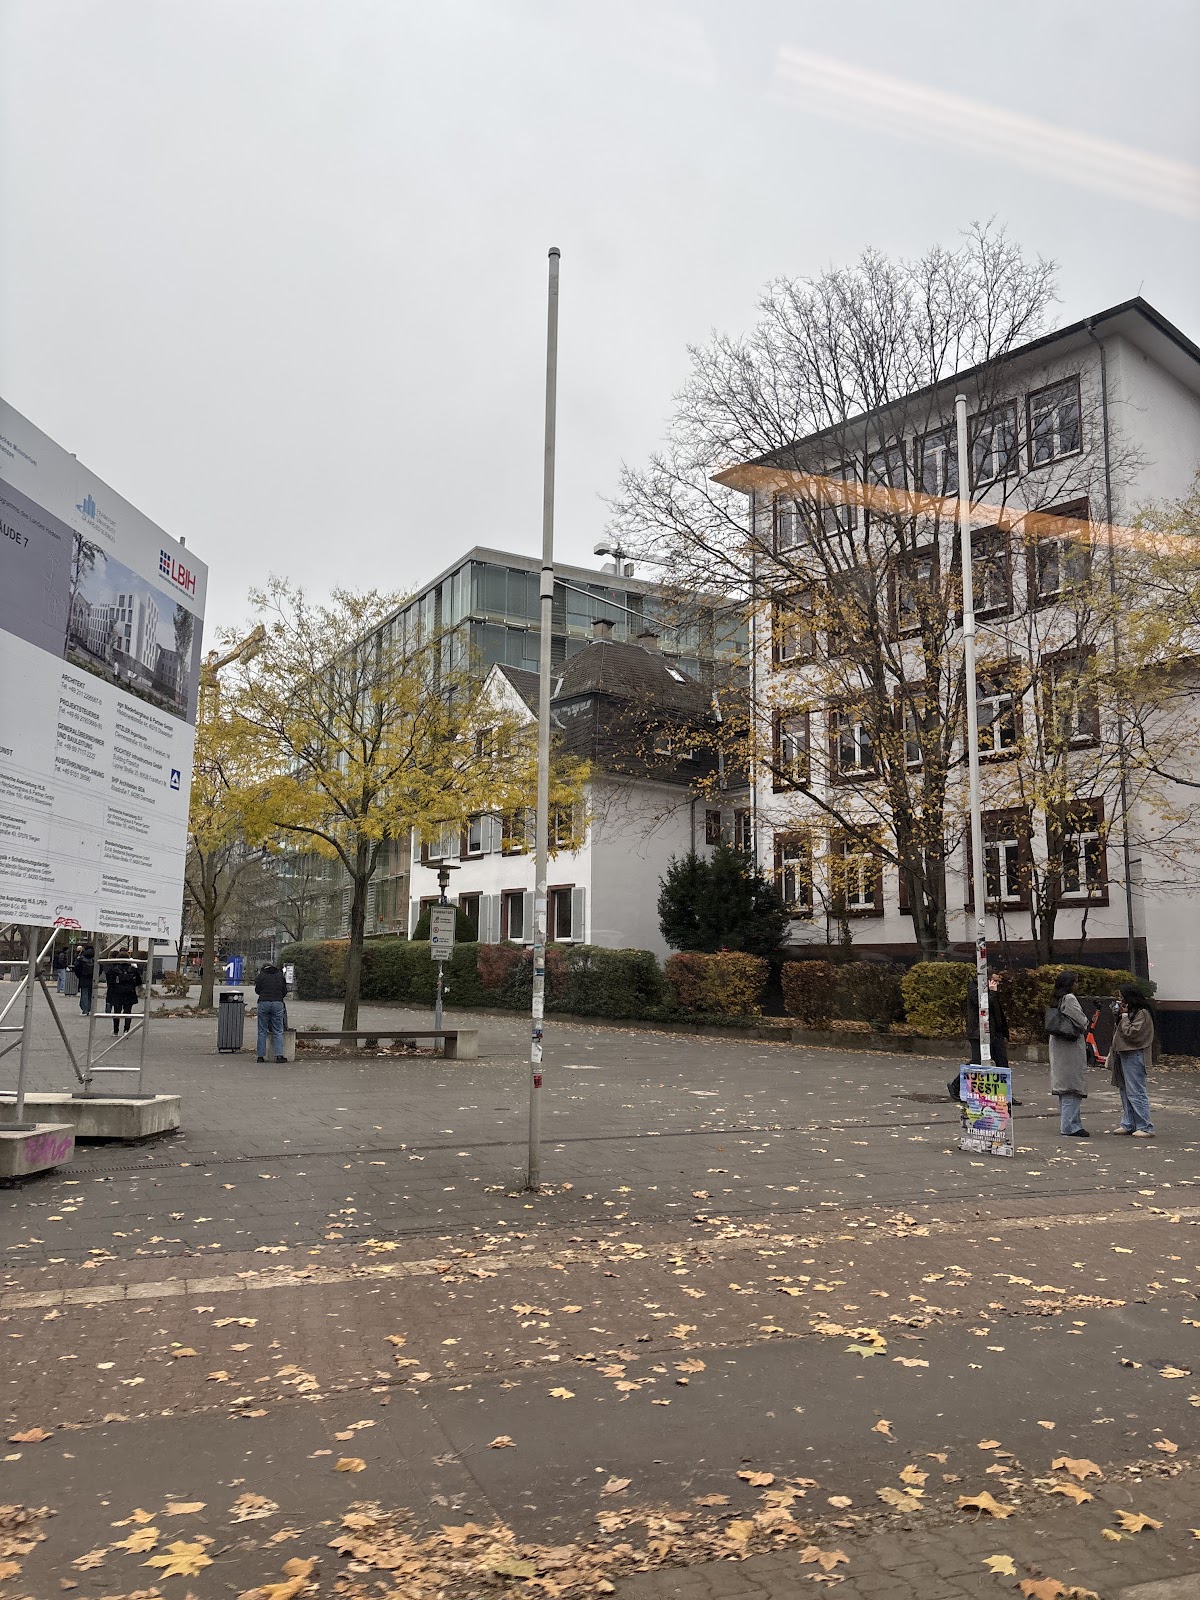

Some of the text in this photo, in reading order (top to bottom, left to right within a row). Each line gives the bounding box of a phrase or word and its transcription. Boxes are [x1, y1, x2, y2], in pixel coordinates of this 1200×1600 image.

[24, 536, 29, 550] 7
[172, 559, 196, 595] LBIH
[62, 673, 85, 690] ARCHITEKT
[60, 698, 100, 721] PROJEKTSTEUERER
[57, 731, 92, 750] UND BAULEITUNG
[114, 746, 131, 758] HOCHTIEF
[971, 1082, 1000, 1095] FEST
